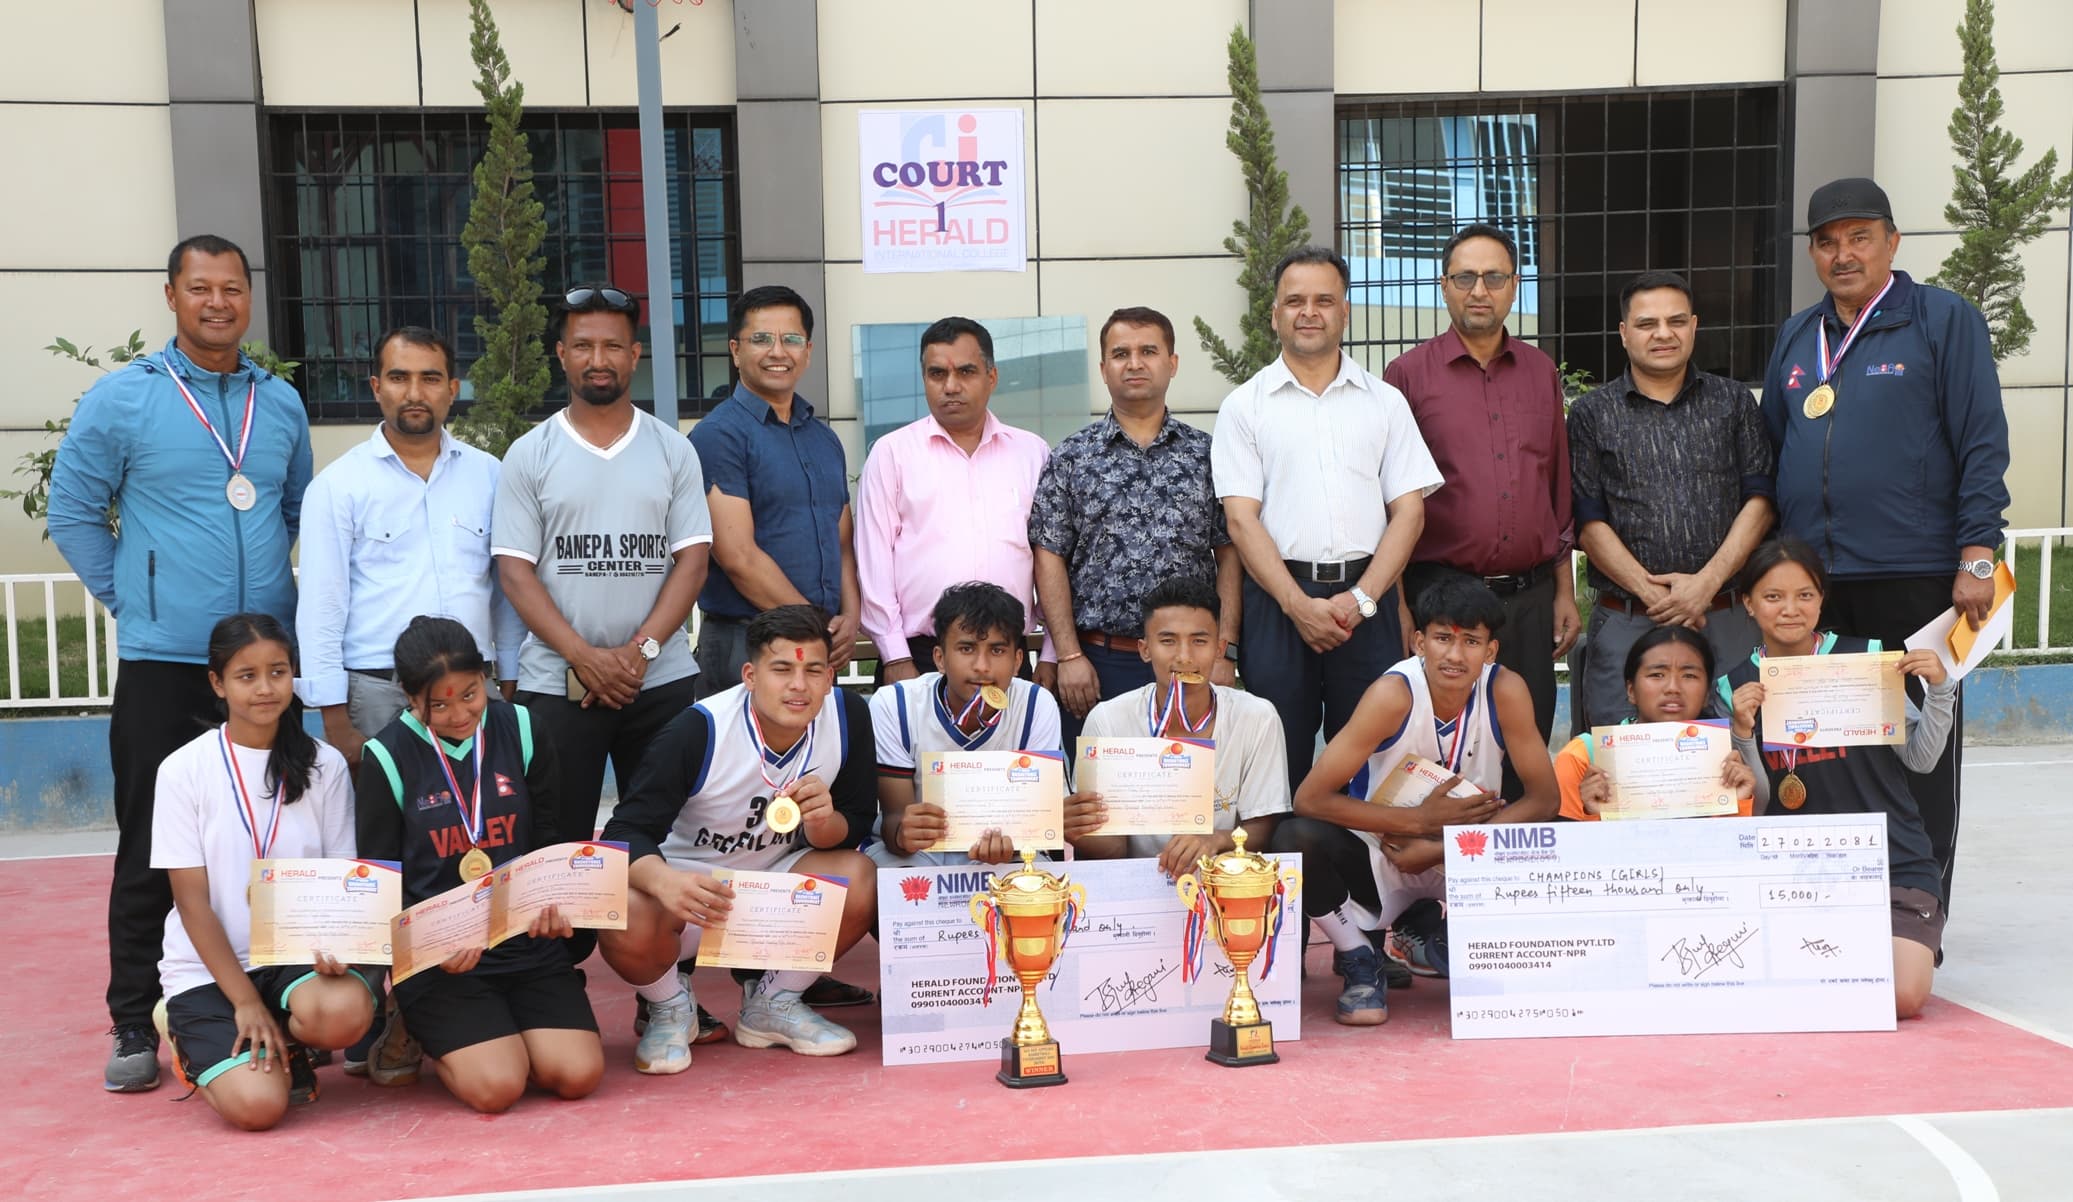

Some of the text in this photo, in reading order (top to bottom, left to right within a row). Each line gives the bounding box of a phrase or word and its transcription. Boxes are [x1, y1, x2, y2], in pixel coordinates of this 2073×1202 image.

[873, 160, 1008, 188] COURT
[933, 201, 949, 232] 1
[873, 218, 1009, 246] HERALD
[555, 533, 667, 560] BANEPA SPORTS
[587, 560, 642, 571] CENTER
[1620, 733, 1651, 742] HERALD
[1843, 728, 1877, 736] HERALD
[1103, 747, 1135, 755] HERALD
[1493, 827, 1557, 850] NIMB
[1738, 834, 1756, 842] Date
[280, 869, 317, 878] HERALD
[1528, 870, 1602, 883] CHAMPIONS
[738, 881, 770, 890] HERALD
[1494, 886, 1539, 906] Rupees
[1546, 884, 1593, 904] fifteen
[938, 930, 980, 944] Rupees
[1468, 939, 1616, 950] HERALD FOUNDATION PVT.LTD
[1469, 950, 1587, 960] CURRENT ACCOUNT-NPR
[1469, 961, 1552, 970] 09901040003414
[911, 975, 1016, 988] HERALD FOUNDION
[911, 988, 955, 998] CURRENT
